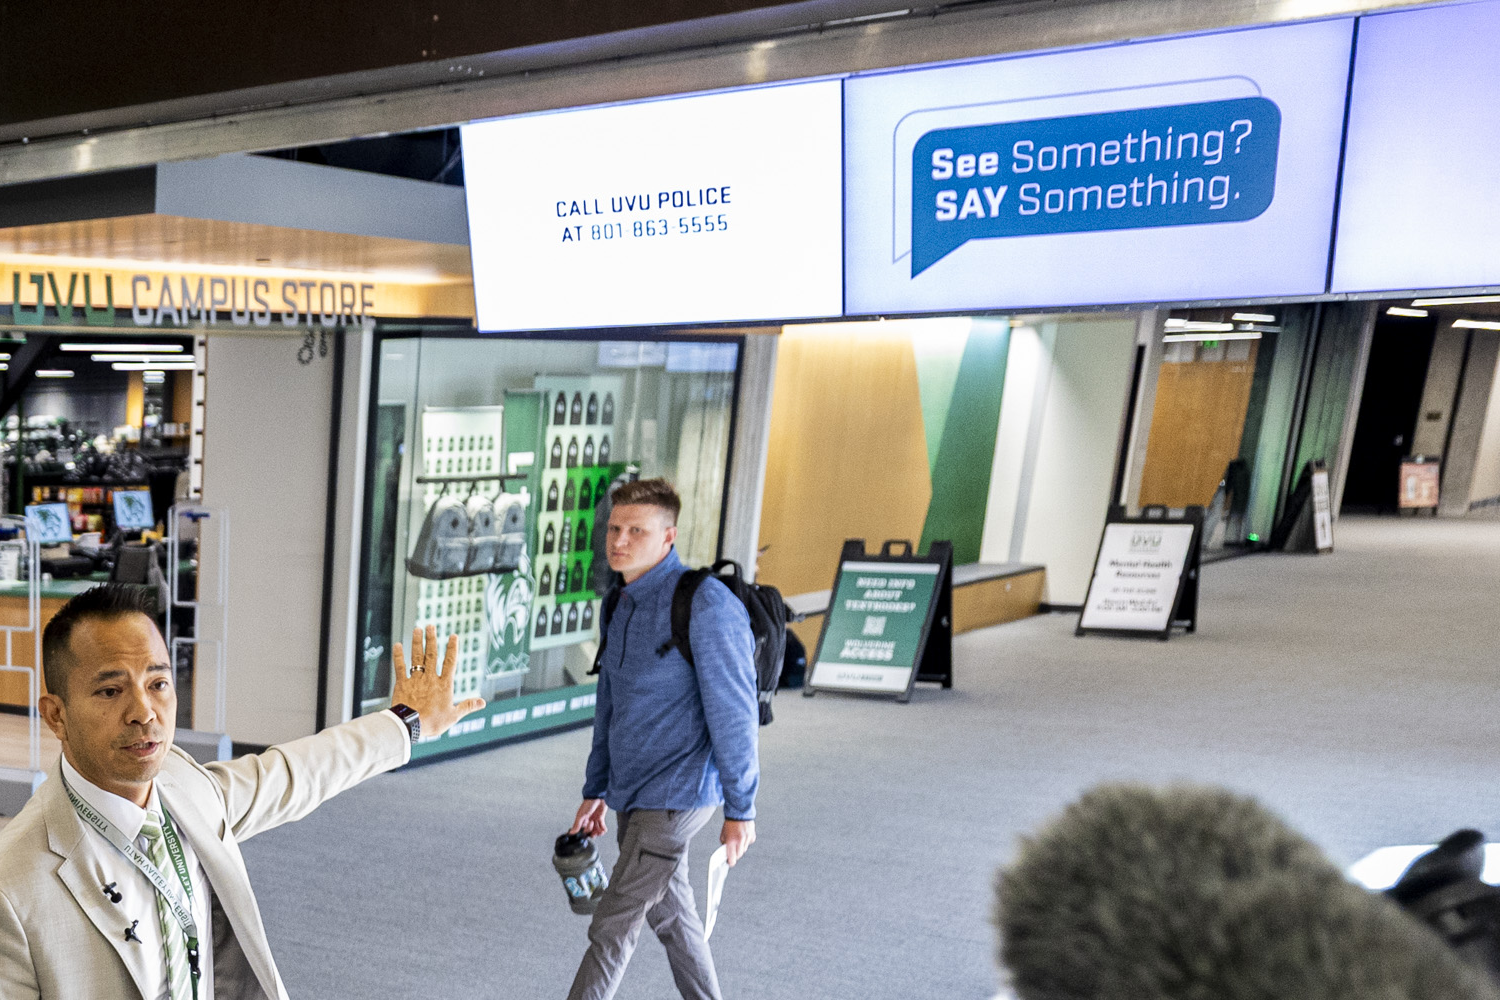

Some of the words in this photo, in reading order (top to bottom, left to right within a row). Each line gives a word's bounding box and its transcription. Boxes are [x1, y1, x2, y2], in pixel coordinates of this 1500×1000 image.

[931, 147, 999, 181] See
[1011, 119, 1253, 174] Something?
[556, 198, 604, 218] CALL
[611, 193, 651, 213] UVU
[658, 186, 732, 209] POLICE
[935, 184, 1008, 222] SAY
[1018, 171, 1241, 217] Something.
[562, 225, 583, 243] AT
[591, 213, 729, 241] 801-863-5555
[12, 271, 114, 326] UVU
[131, 274, 272, 327] CAMPUS
[280, 279, 375, 328] STORE
[856, 577, 887, 588] NEED
[887, 578, 916, 590] INFO
[863, 589, 903, 601] ABOUT
[839, 648, 894, 661] ACCESS
[162, 825, 188, 876] UNIVERSITY
